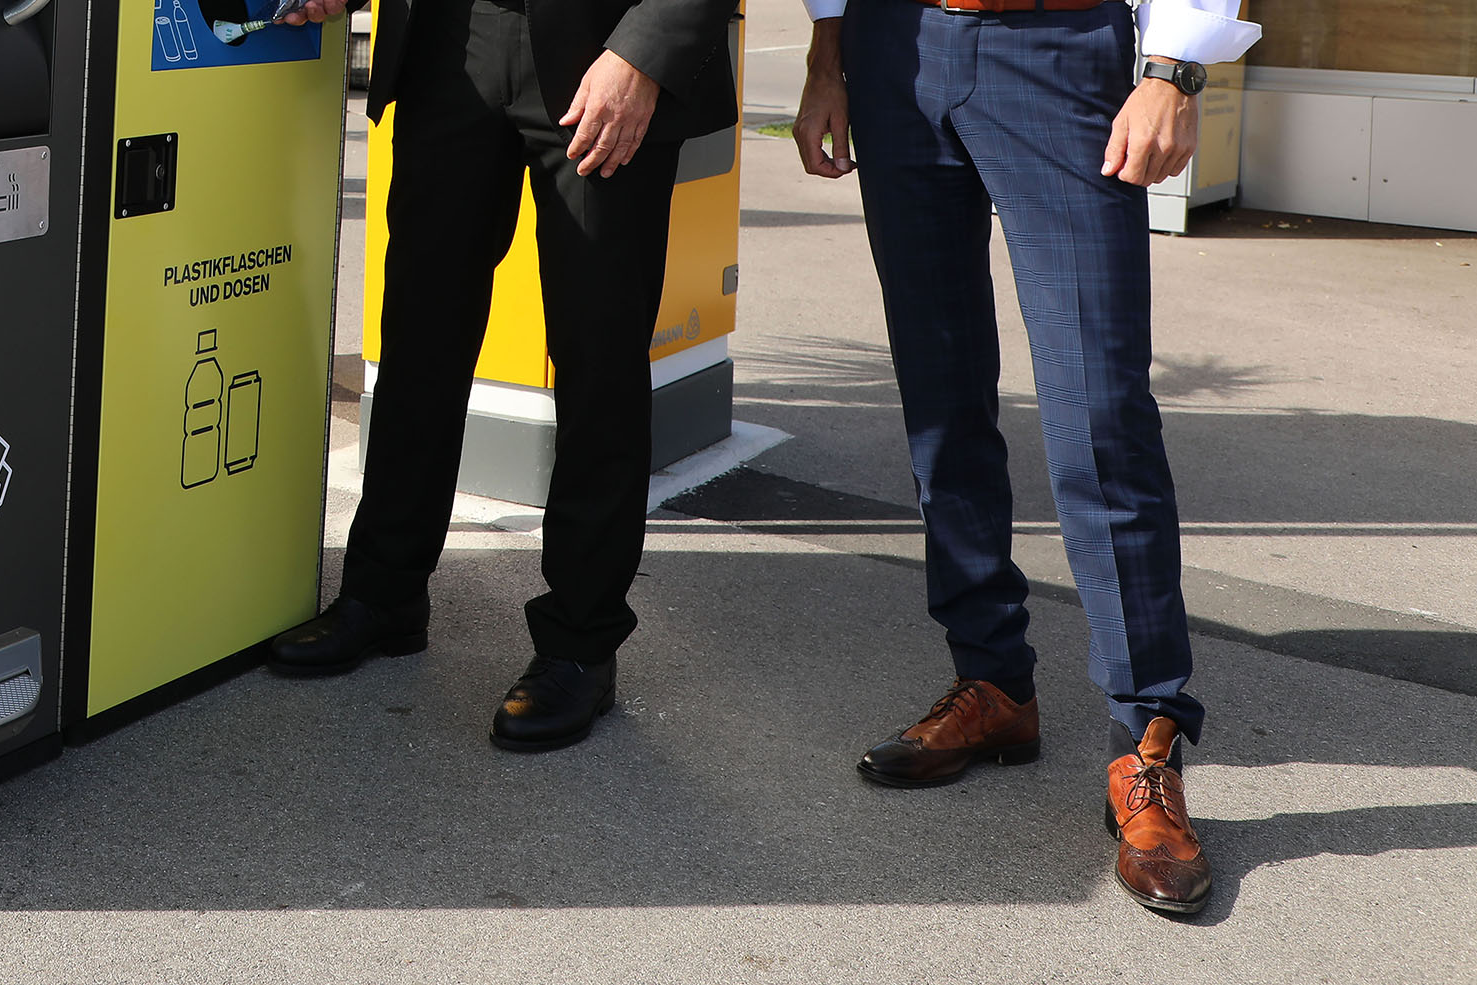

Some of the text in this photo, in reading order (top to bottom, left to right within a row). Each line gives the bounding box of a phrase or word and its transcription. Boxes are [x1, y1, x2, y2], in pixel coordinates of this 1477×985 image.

[163, 244, 292, 287] PLASTIKFLASCHEN
[189, 273, 270, 307] UND DOSEN
